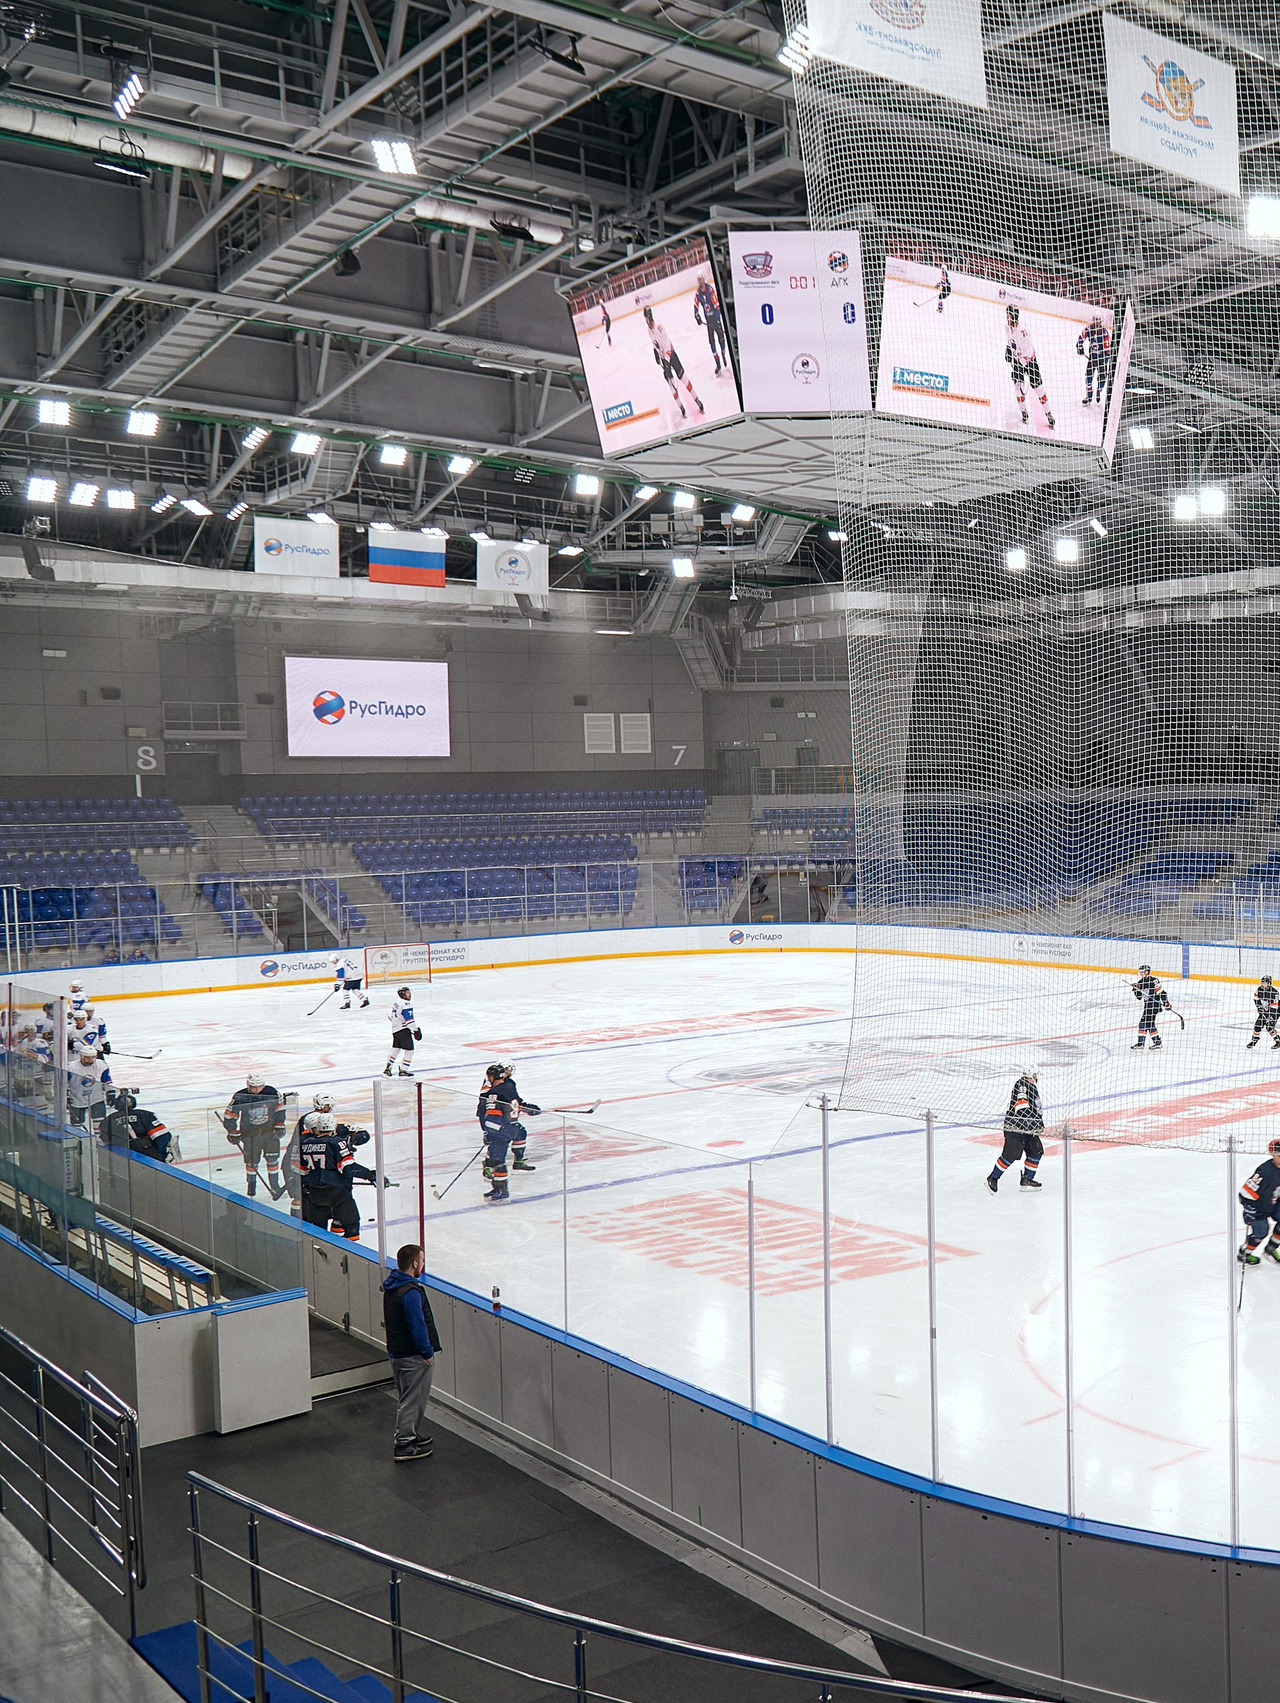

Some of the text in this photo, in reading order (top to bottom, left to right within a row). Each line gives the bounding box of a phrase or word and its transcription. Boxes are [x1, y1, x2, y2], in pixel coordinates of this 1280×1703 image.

[789, 276, 816, 289] 0:01
[761, 303, 775, 325] 0
[842, 301, 856, 325] 0
[894, 367, 944, 388] 1 место
[607, 404, 631, 421] место
[285, 543, 331, 556] РусГидро
[349, 700, 426, 719] РусГидро
[671, 745, 687, 767] 7
[746, 932, 783, 942] РусГидро
[281, 961, 328, 972] РусГидро
[431, 954, 465, 962] РУСГИДРО
[301, 1143, 327, 1153] ЧУДИНОВ
[613, 1190, 953, 1281] МАШИНА
[586, 1226, 843, 1297] КРАСНАЯ
